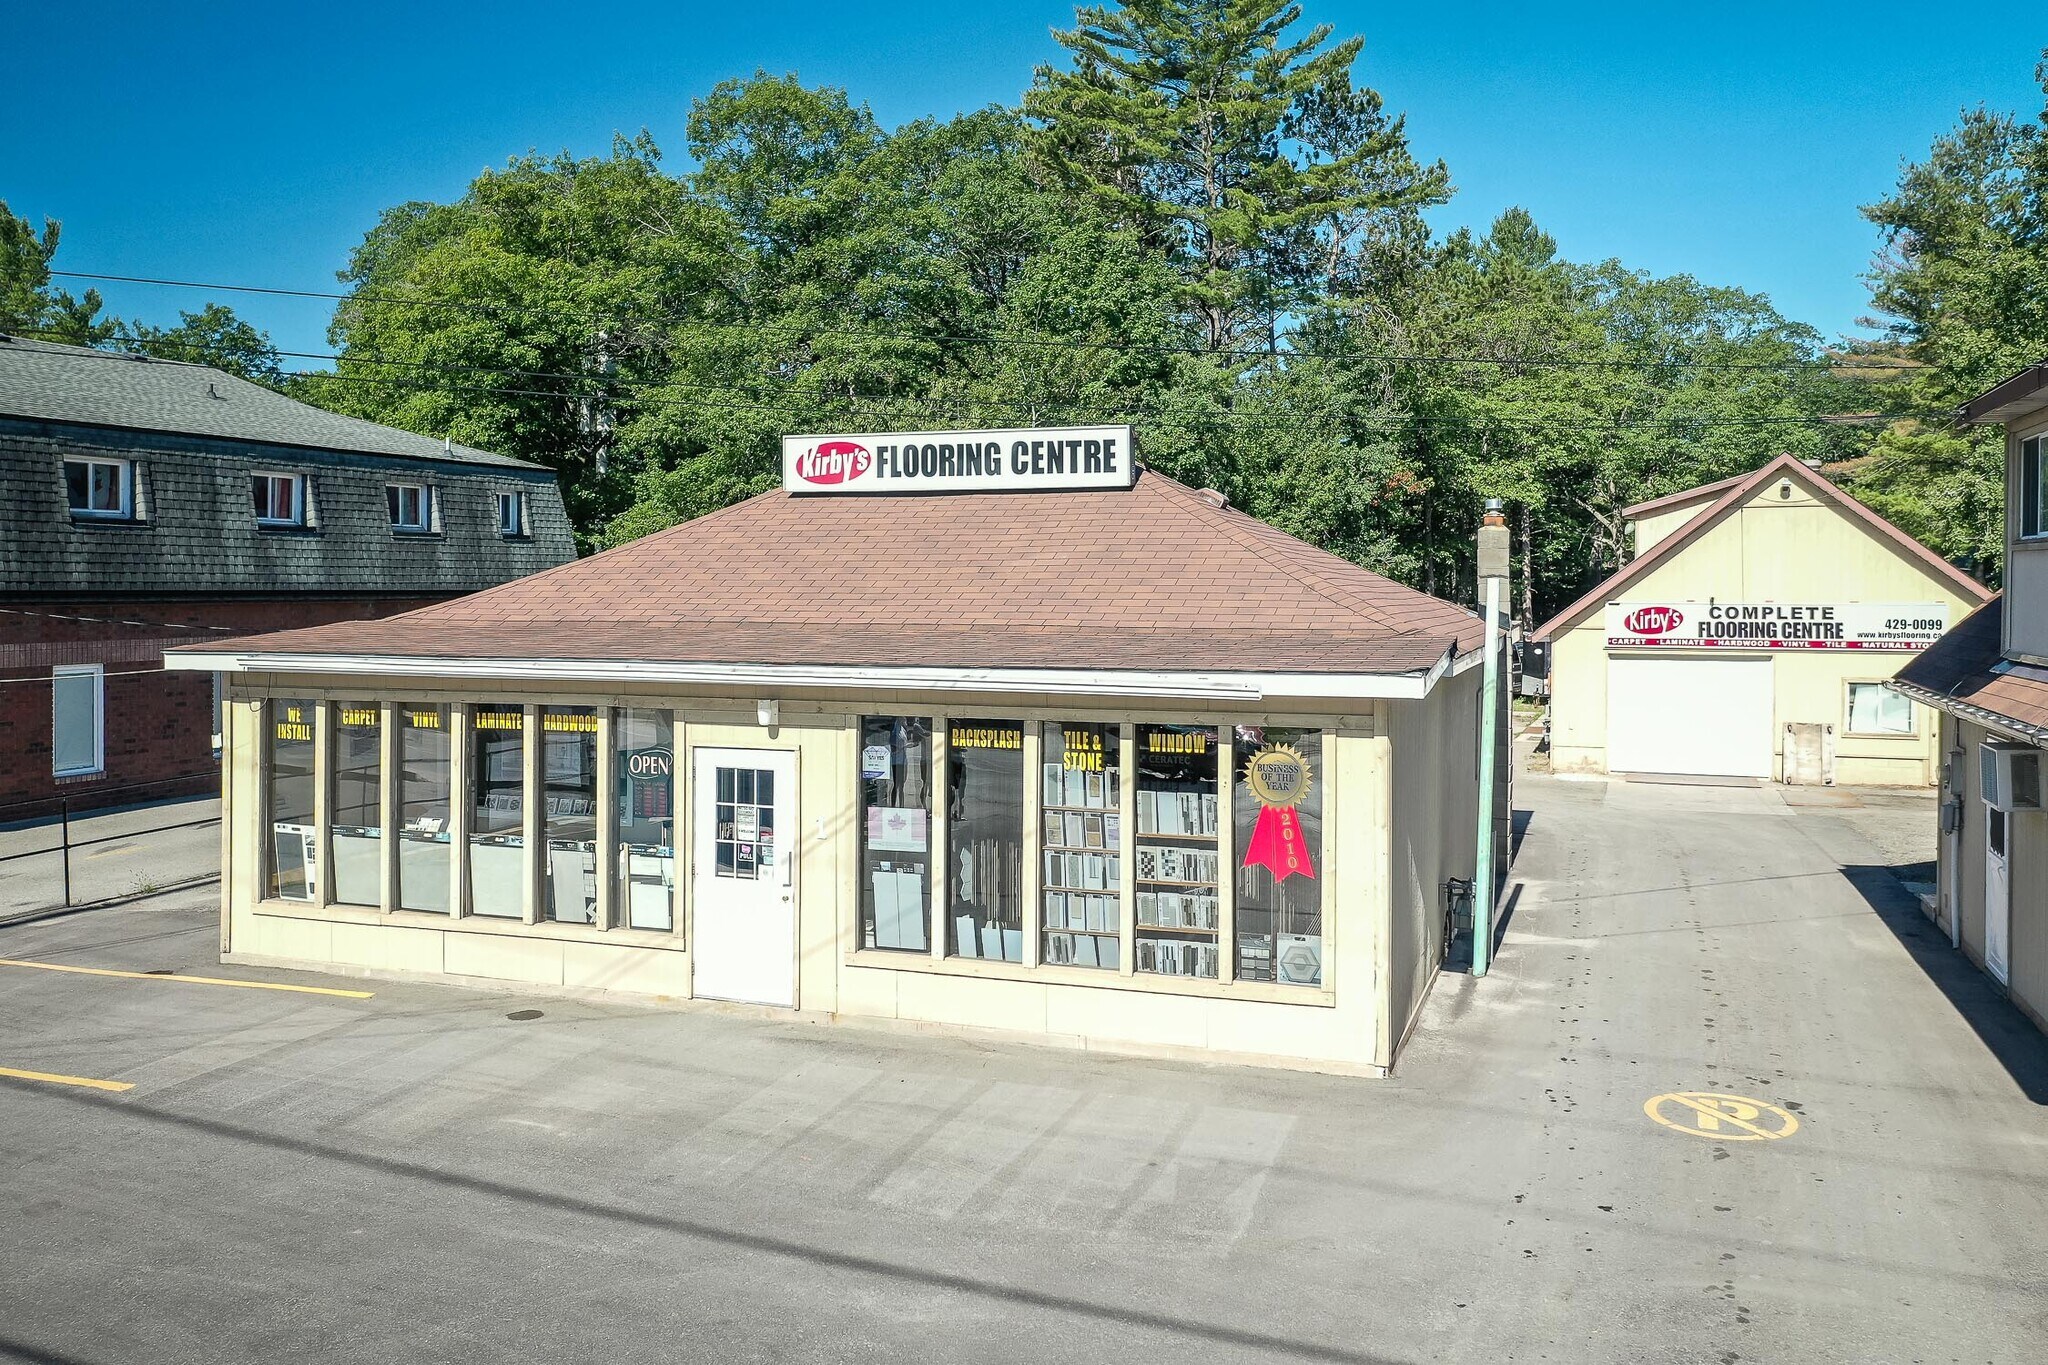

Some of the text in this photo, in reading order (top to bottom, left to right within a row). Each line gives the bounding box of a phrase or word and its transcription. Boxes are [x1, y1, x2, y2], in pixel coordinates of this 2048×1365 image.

[800, 439, 1117, 483] Kirby's FLOORING CENTRE
[1629, 607, 1682, 633] Kirby's
[1709, 606, 1834, 620] COMPLETE
[1698, 621, 1844, 640] FLOORING CENTRE
[1885, 619, 1943, 631] 429-0099
[287, 707, 301, 722] WE
[342, 709, 376, 726] CARPET
[412, 711, 439, 728] VINYL
[476, 712, 522, 730] LAMINATE
[544, 714, 597, 732] HARDWOOD
[277, 724, 310, 740] INSTALL
[952, 728, 1020, 749] BACKSPLASH
[1064, 731, 1102, 750] TILE &
[1149, 733, 1206, 754] WINDOW
[629, 754, 669, 776] OPEN
[1063, 752, 1103, 772] STONE
[1257, 763, 1299, 774] BUSINESS
[1260, 773, 1295, 783] OF THE
[1265, 781, 1290, 791] YEAR
